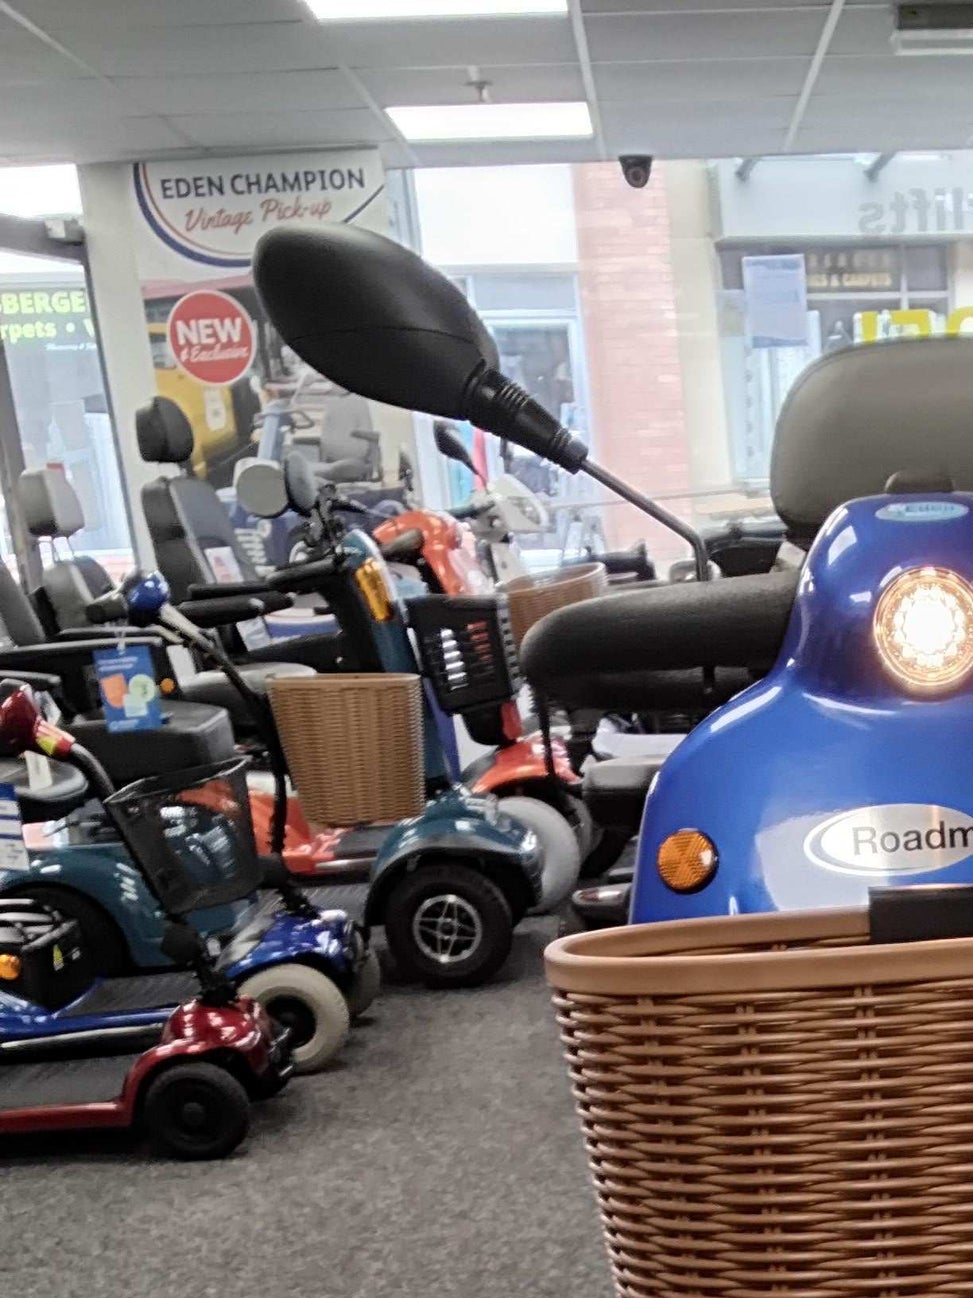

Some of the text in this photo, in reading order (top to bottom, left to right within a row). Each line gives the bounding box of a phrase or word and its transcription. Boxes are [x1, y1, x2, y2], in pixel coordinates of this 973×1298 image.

[160, 167, 365, 199] EDEN CHAMPION
[185, 197, 332, 235] Vintage Pick-up
[0, 291, 86, 314] BERGE
[176, 316, 242, 345] NEW
